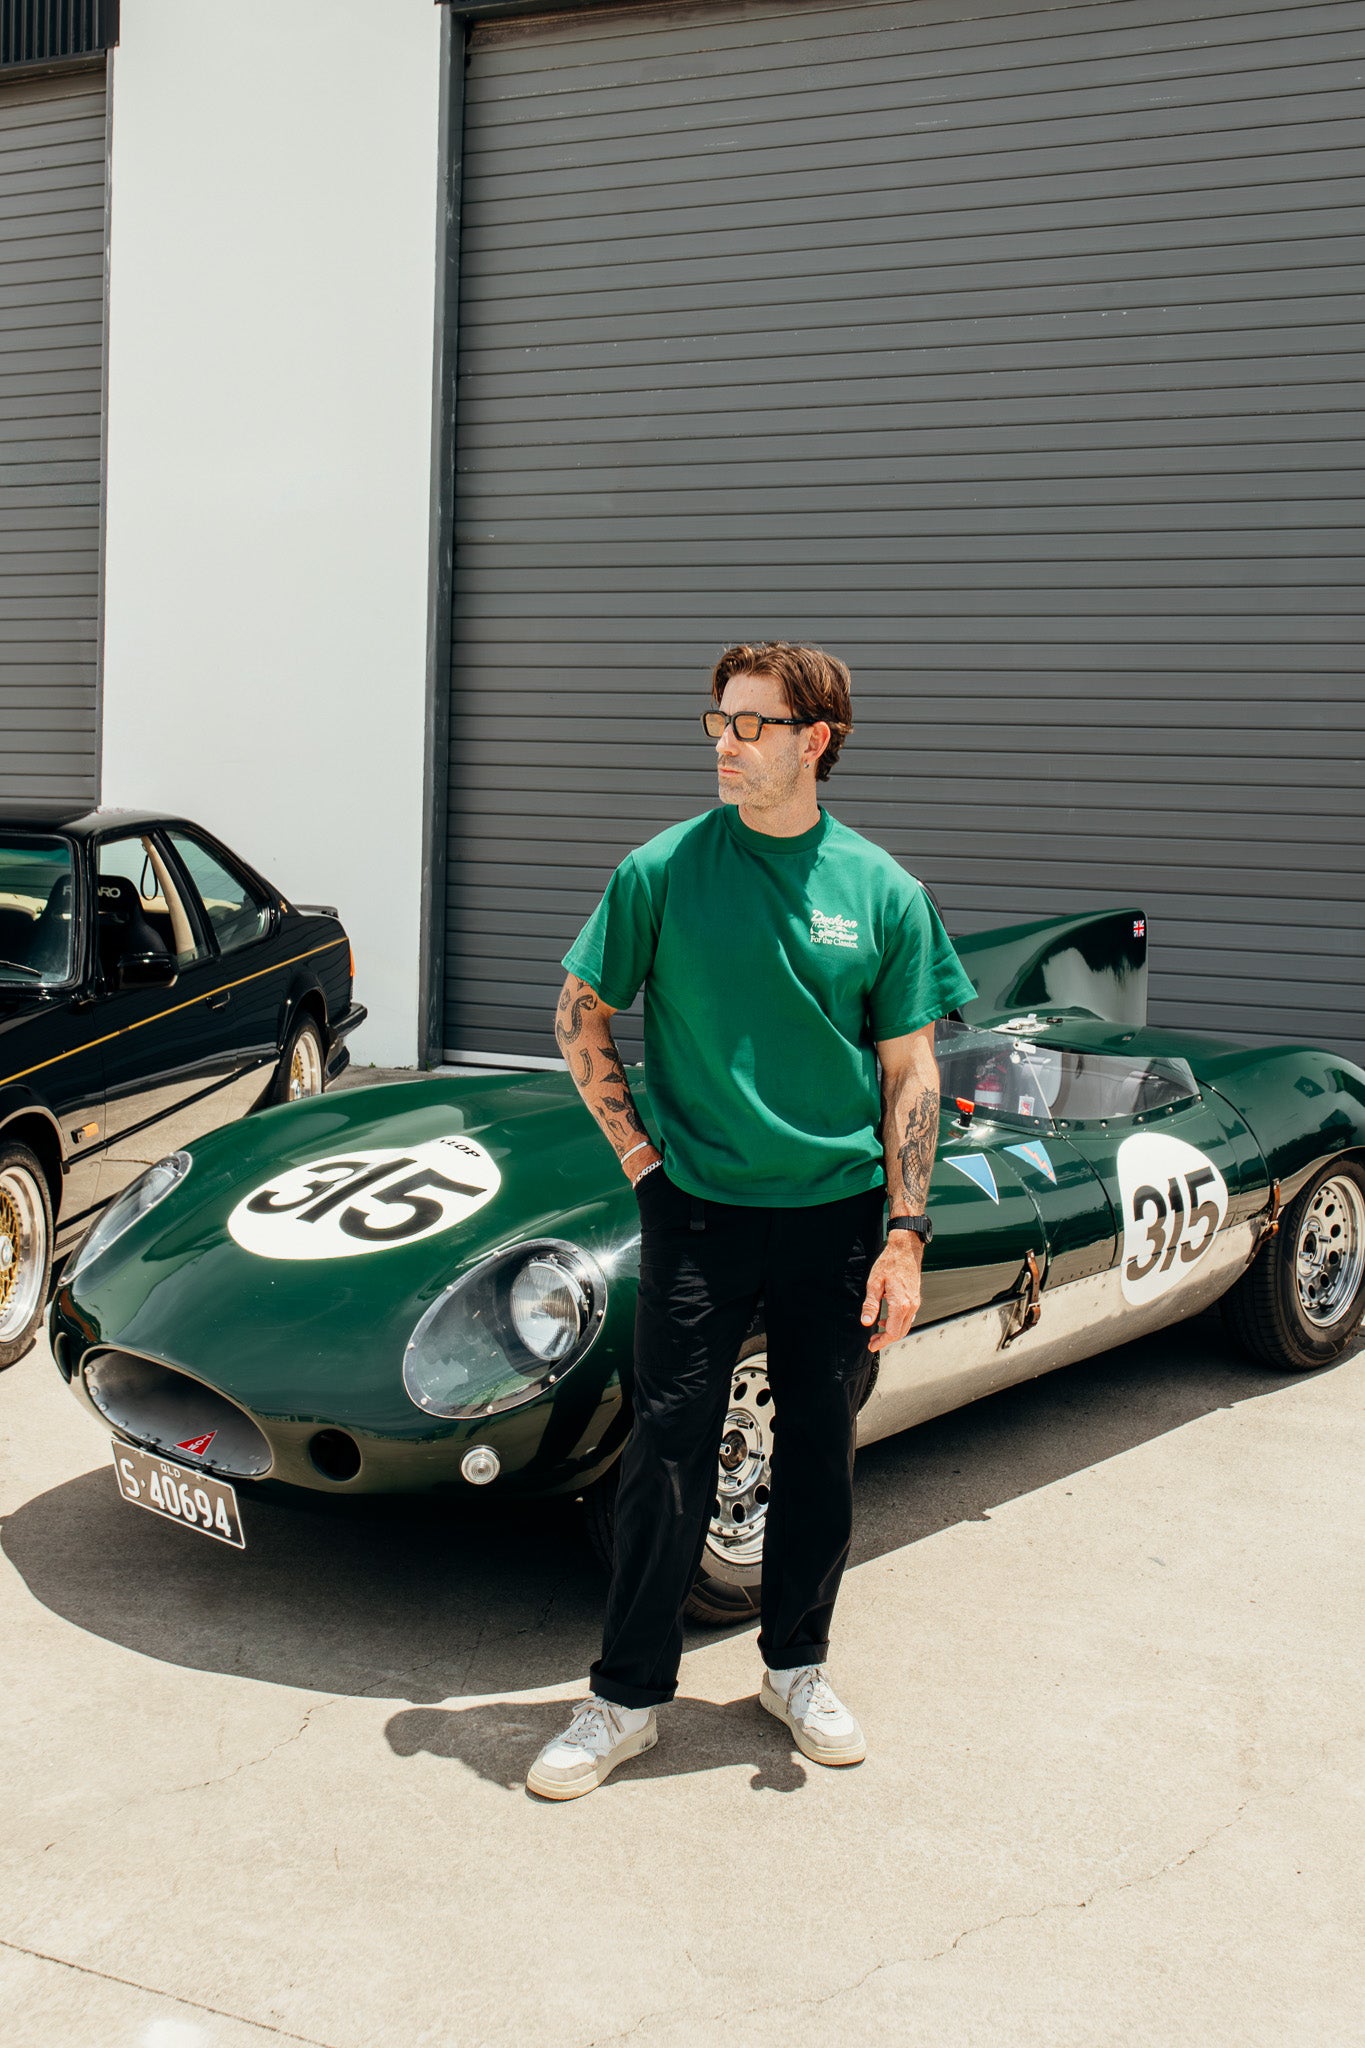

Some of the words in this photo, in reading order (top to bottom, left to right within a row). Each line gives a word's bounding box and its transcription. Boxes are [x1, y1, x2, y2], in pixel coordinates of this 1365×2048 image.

[62, 885, 121, 898] RRO
[810, 935, 821, 943] For
[822, 936, 833, 945] the
[246, 1157, 488, 1241] 315
[1126, 1166, 1220, 1281] 315
[187, 1434, 212, 1451] TOW
[160, 1463, 181, 1479] QLD
